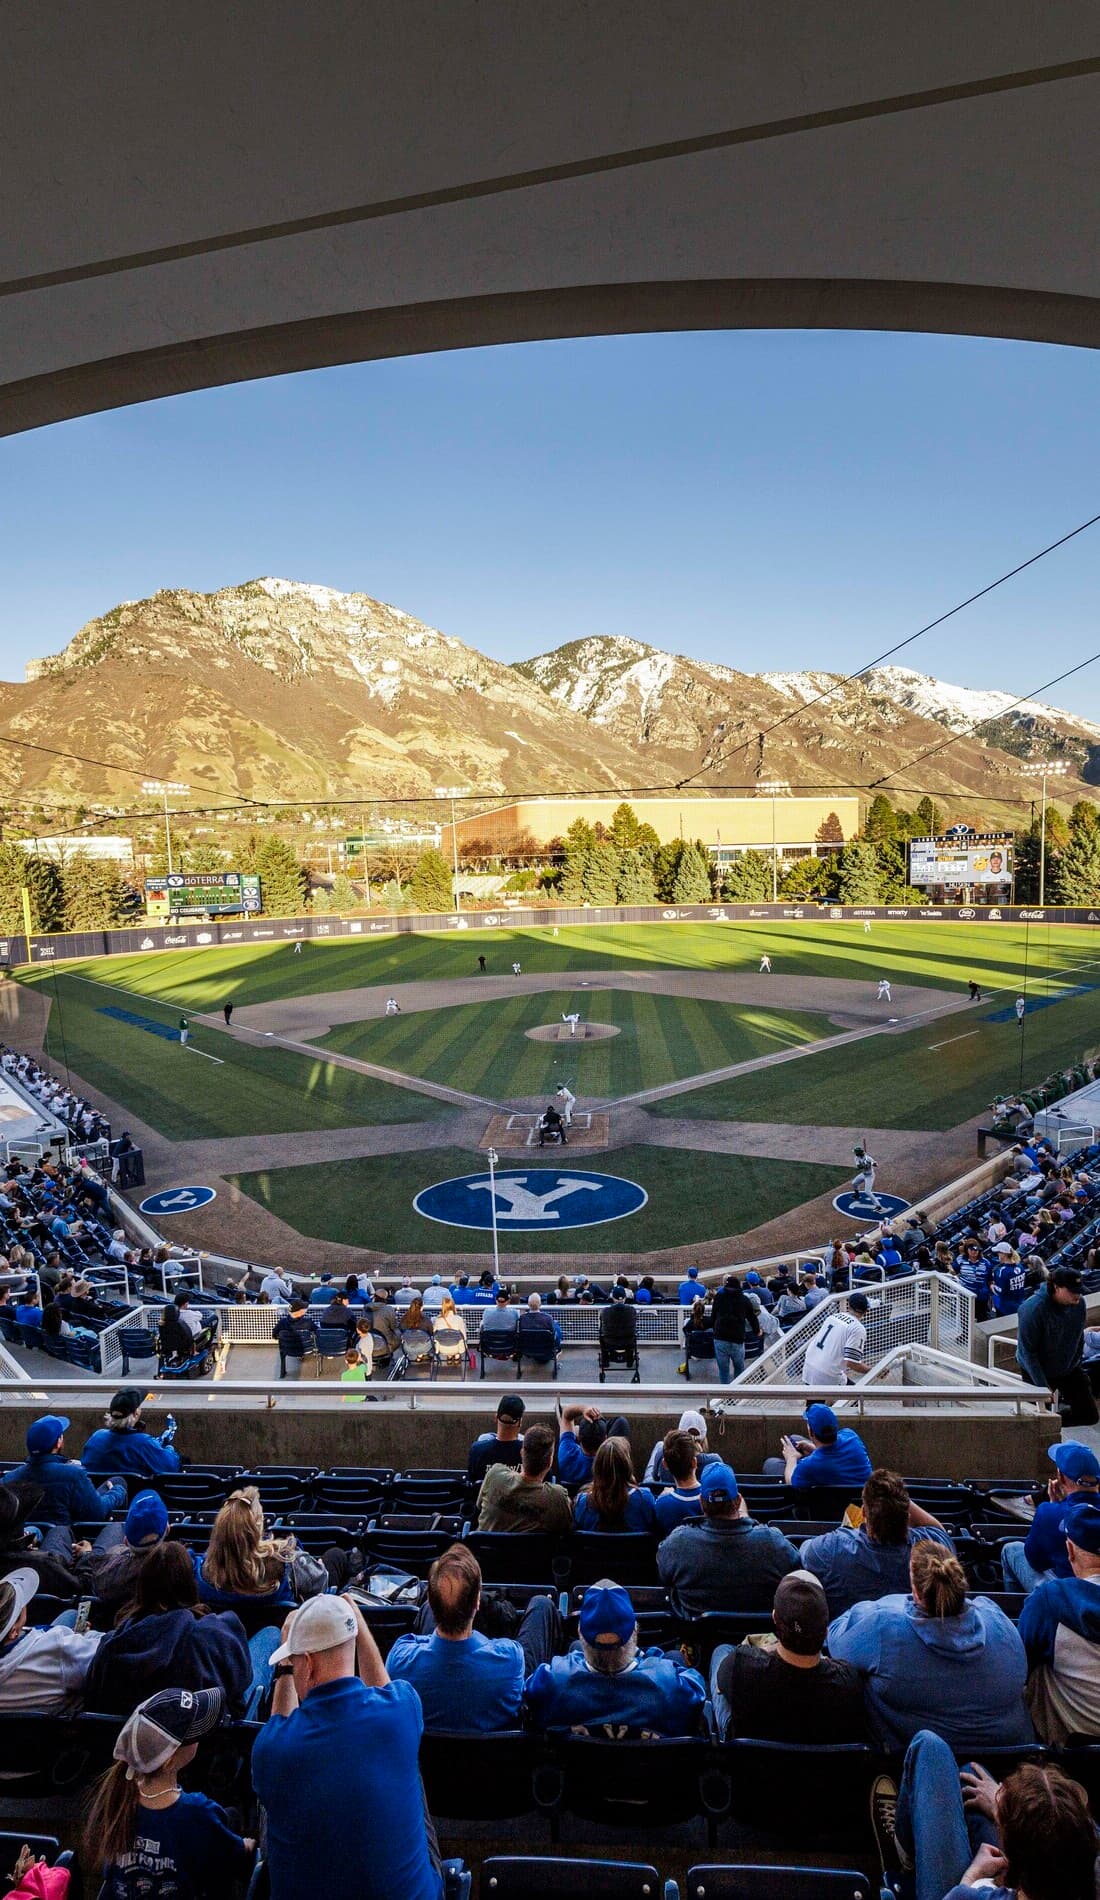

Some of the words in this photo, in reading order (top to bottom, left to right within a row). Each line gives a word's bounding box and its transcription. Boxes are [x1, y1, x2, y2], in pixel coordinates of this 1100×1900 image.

[160, 1191, 197, 1208] Y
[466, 1177, 604, 1220] Y
[816, 1324, 834, 1350] 1
[116, 1851, 138, 1869] UILT
